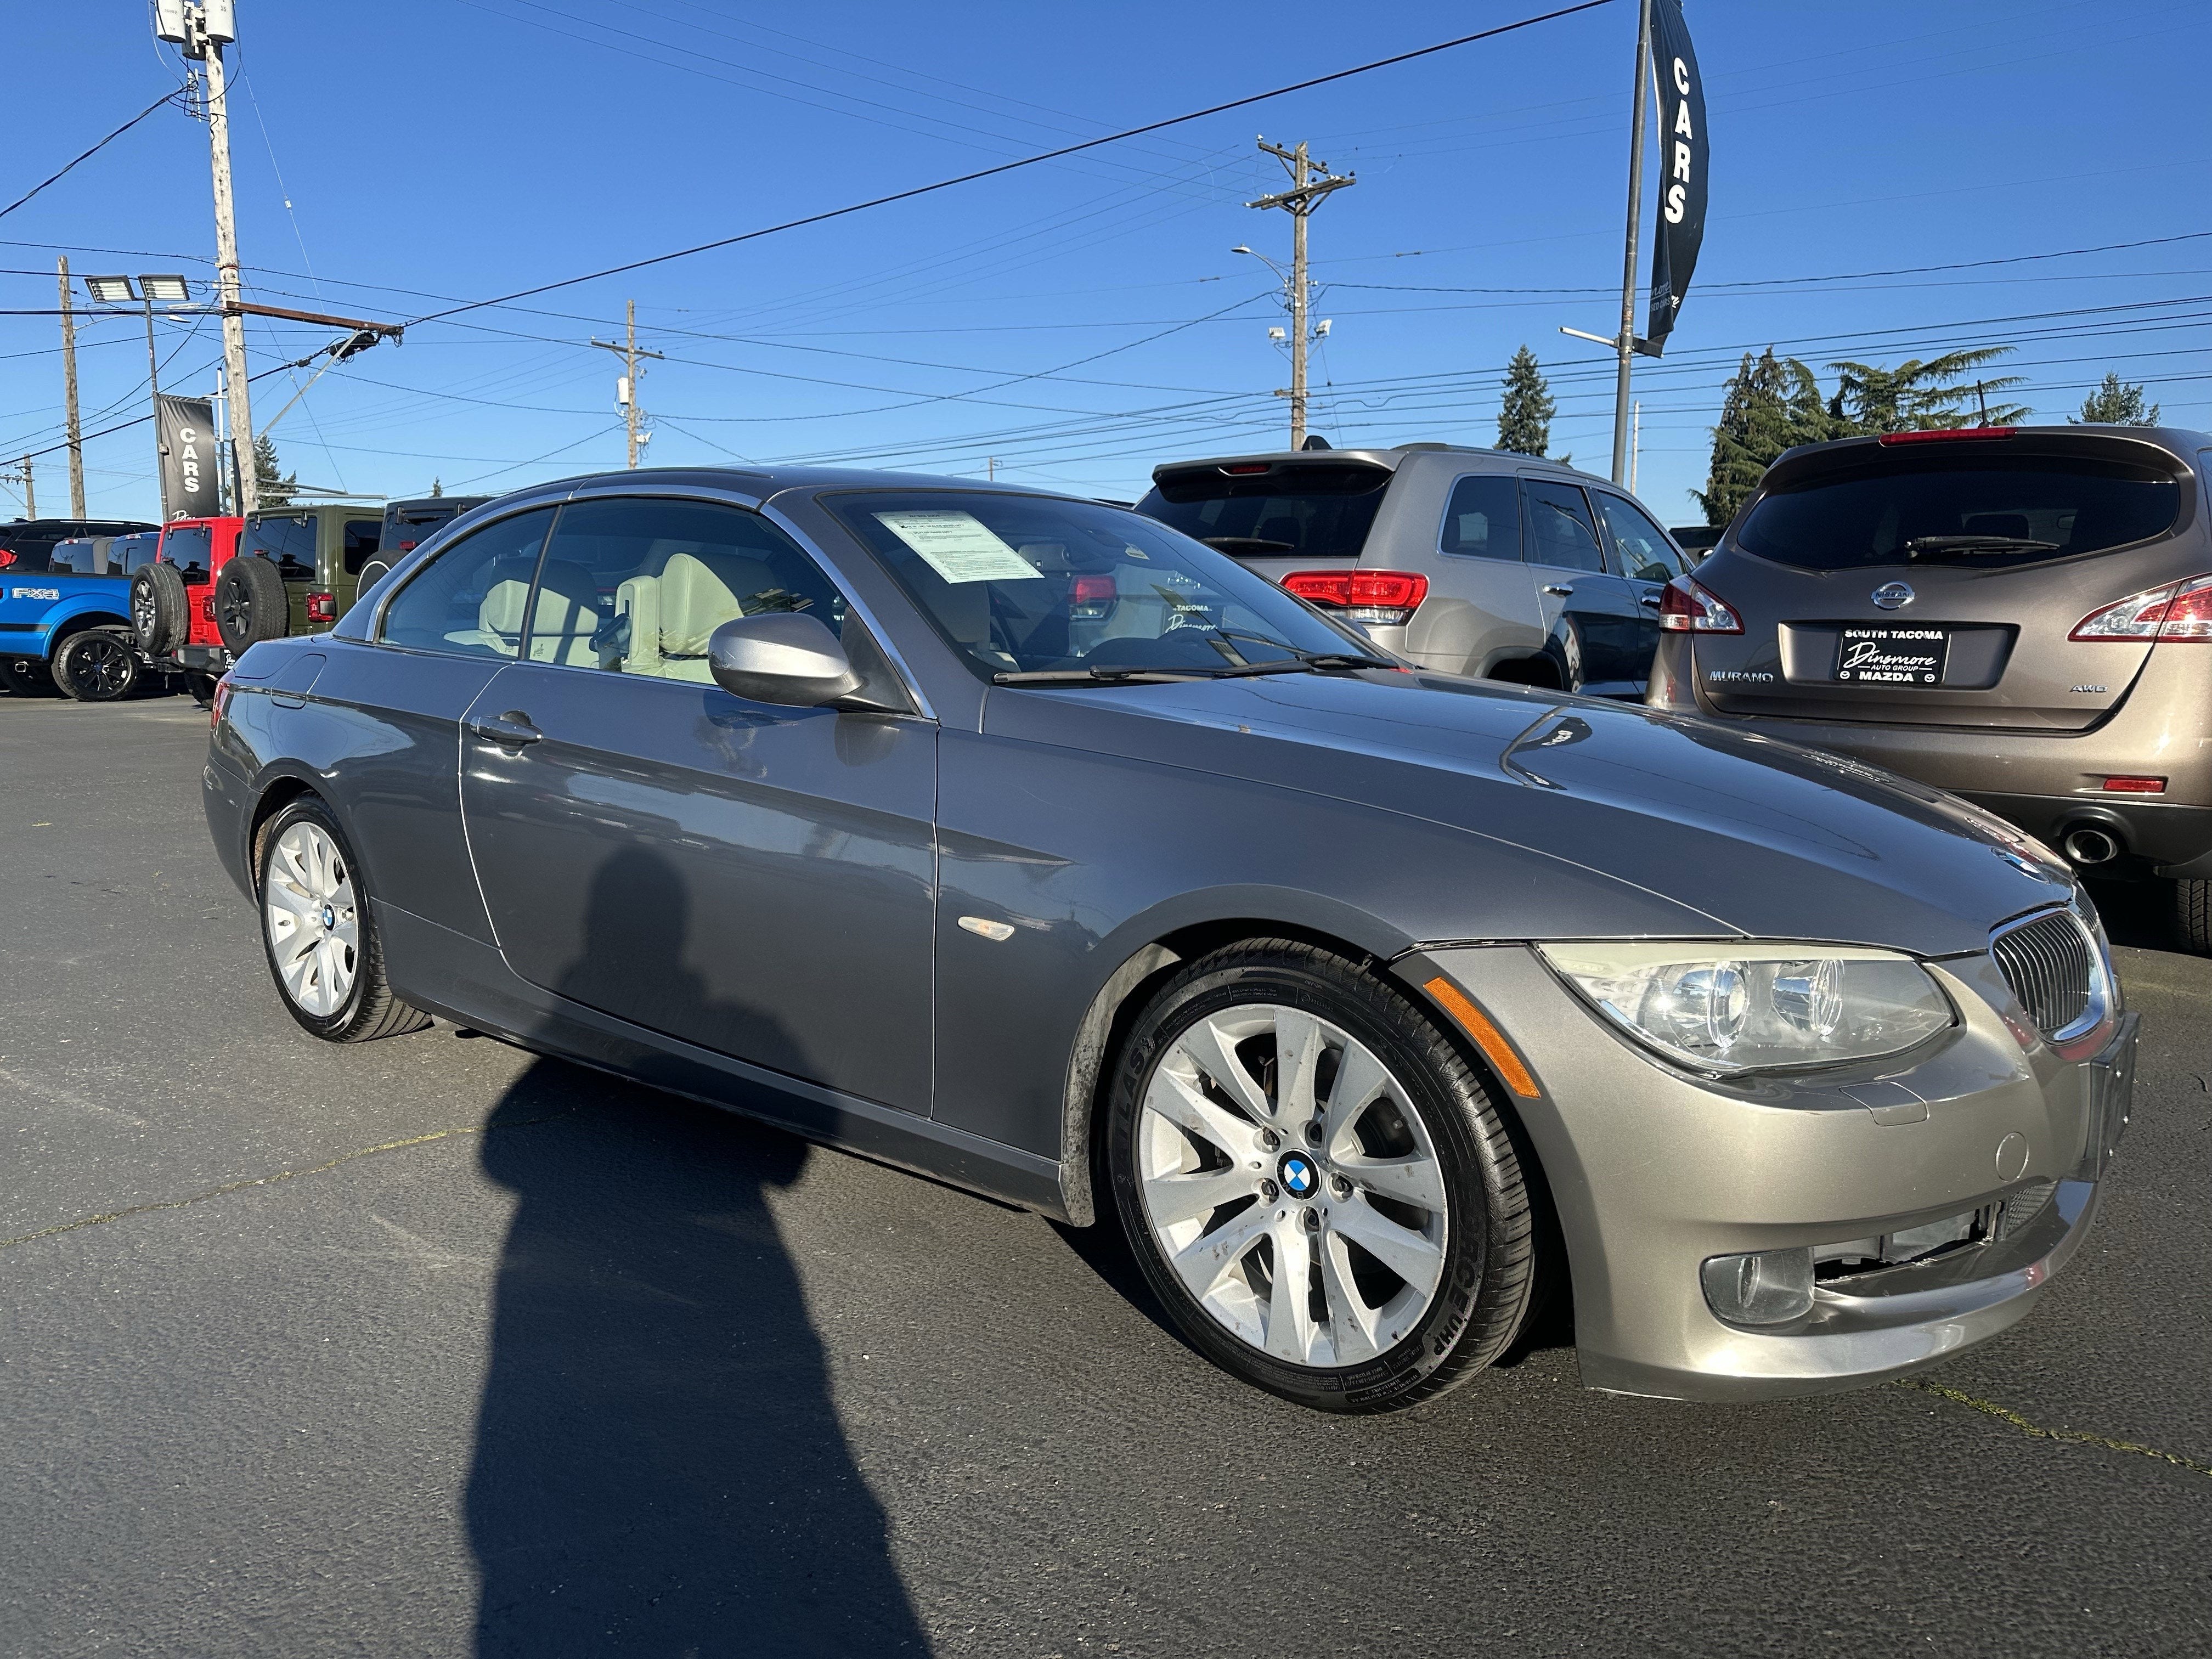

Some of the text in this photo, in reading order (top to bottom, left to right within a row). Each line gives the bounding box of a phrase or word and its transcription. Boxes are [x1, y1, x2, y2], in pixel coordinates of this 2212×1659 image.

[1664, 57, 1692, 224] CARS
[180, 427, 199, 493] CARS
[12, 588, 59, 600] FX4
[1844, 629, 1943, 640] SOUTH TACOMA
[1843, 641, 1937, 668] Dinsmore
[1709, 670, 1774, 682] MURANO
[1859, 671, 1914, 682] MAZDA
[1113, 1047, 1145, 1169] ATLAS
[1277, 1164, 1305, 1199] BMW
[1433, 1313, 1463, 1356] UHP
